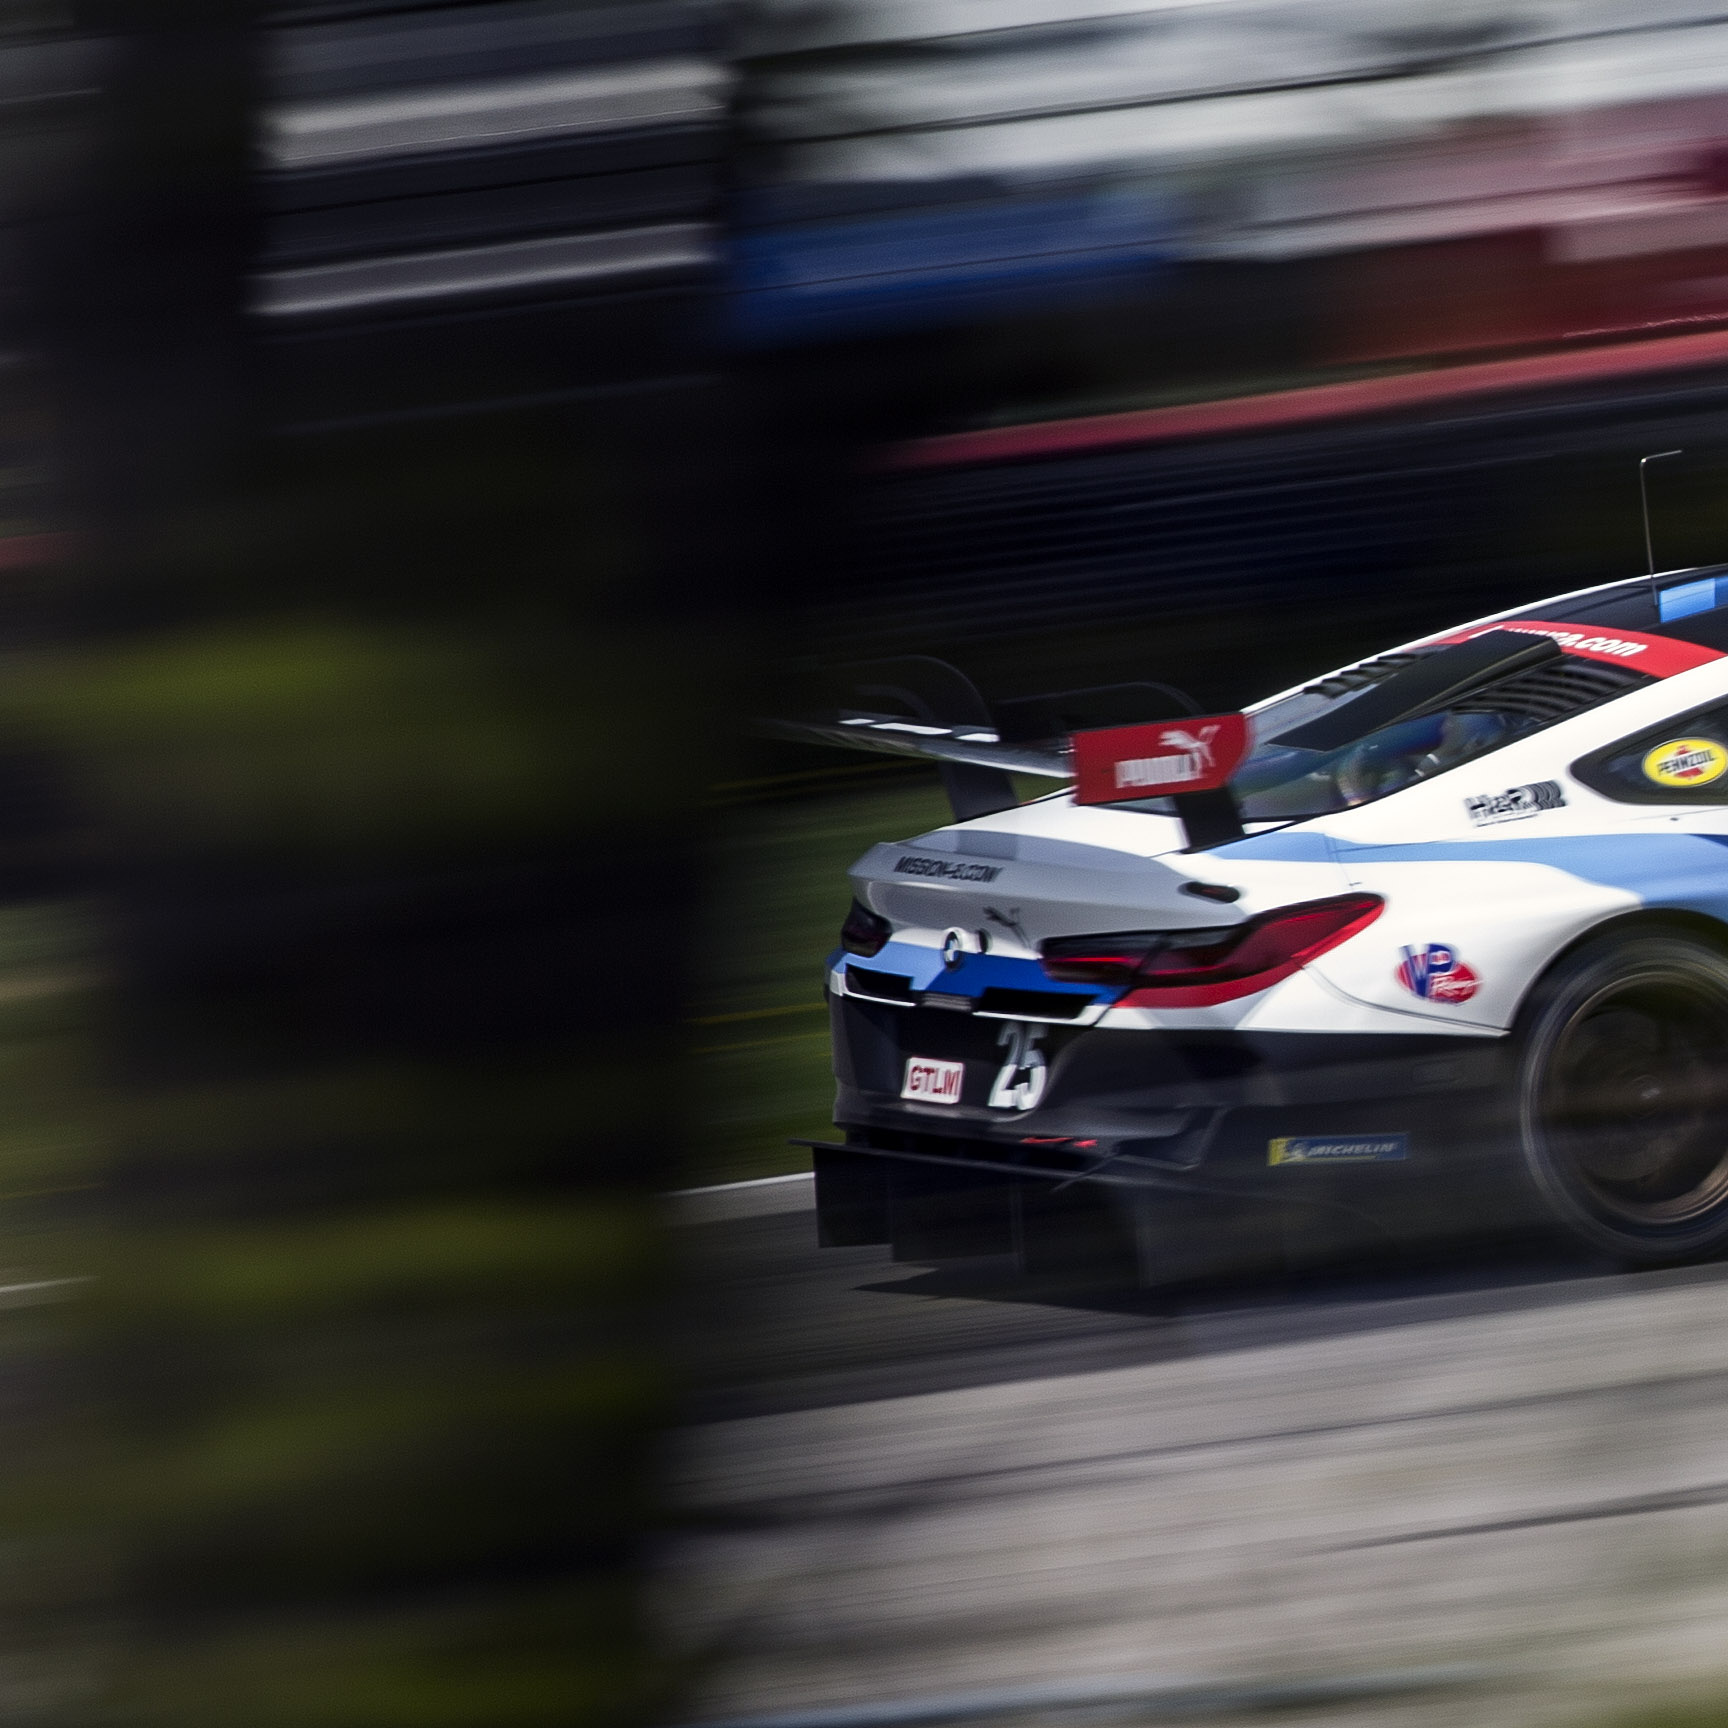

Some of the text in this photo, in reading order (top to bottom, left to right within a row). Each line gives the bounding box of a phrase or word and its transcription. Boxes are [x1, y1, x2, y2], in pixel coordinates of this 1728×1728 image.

[909, 1065, 961, 1096] GTLM
[987, 1022, 1049, 1111] 25
[1308, 1142, 1396, 1156] MICHELIN
